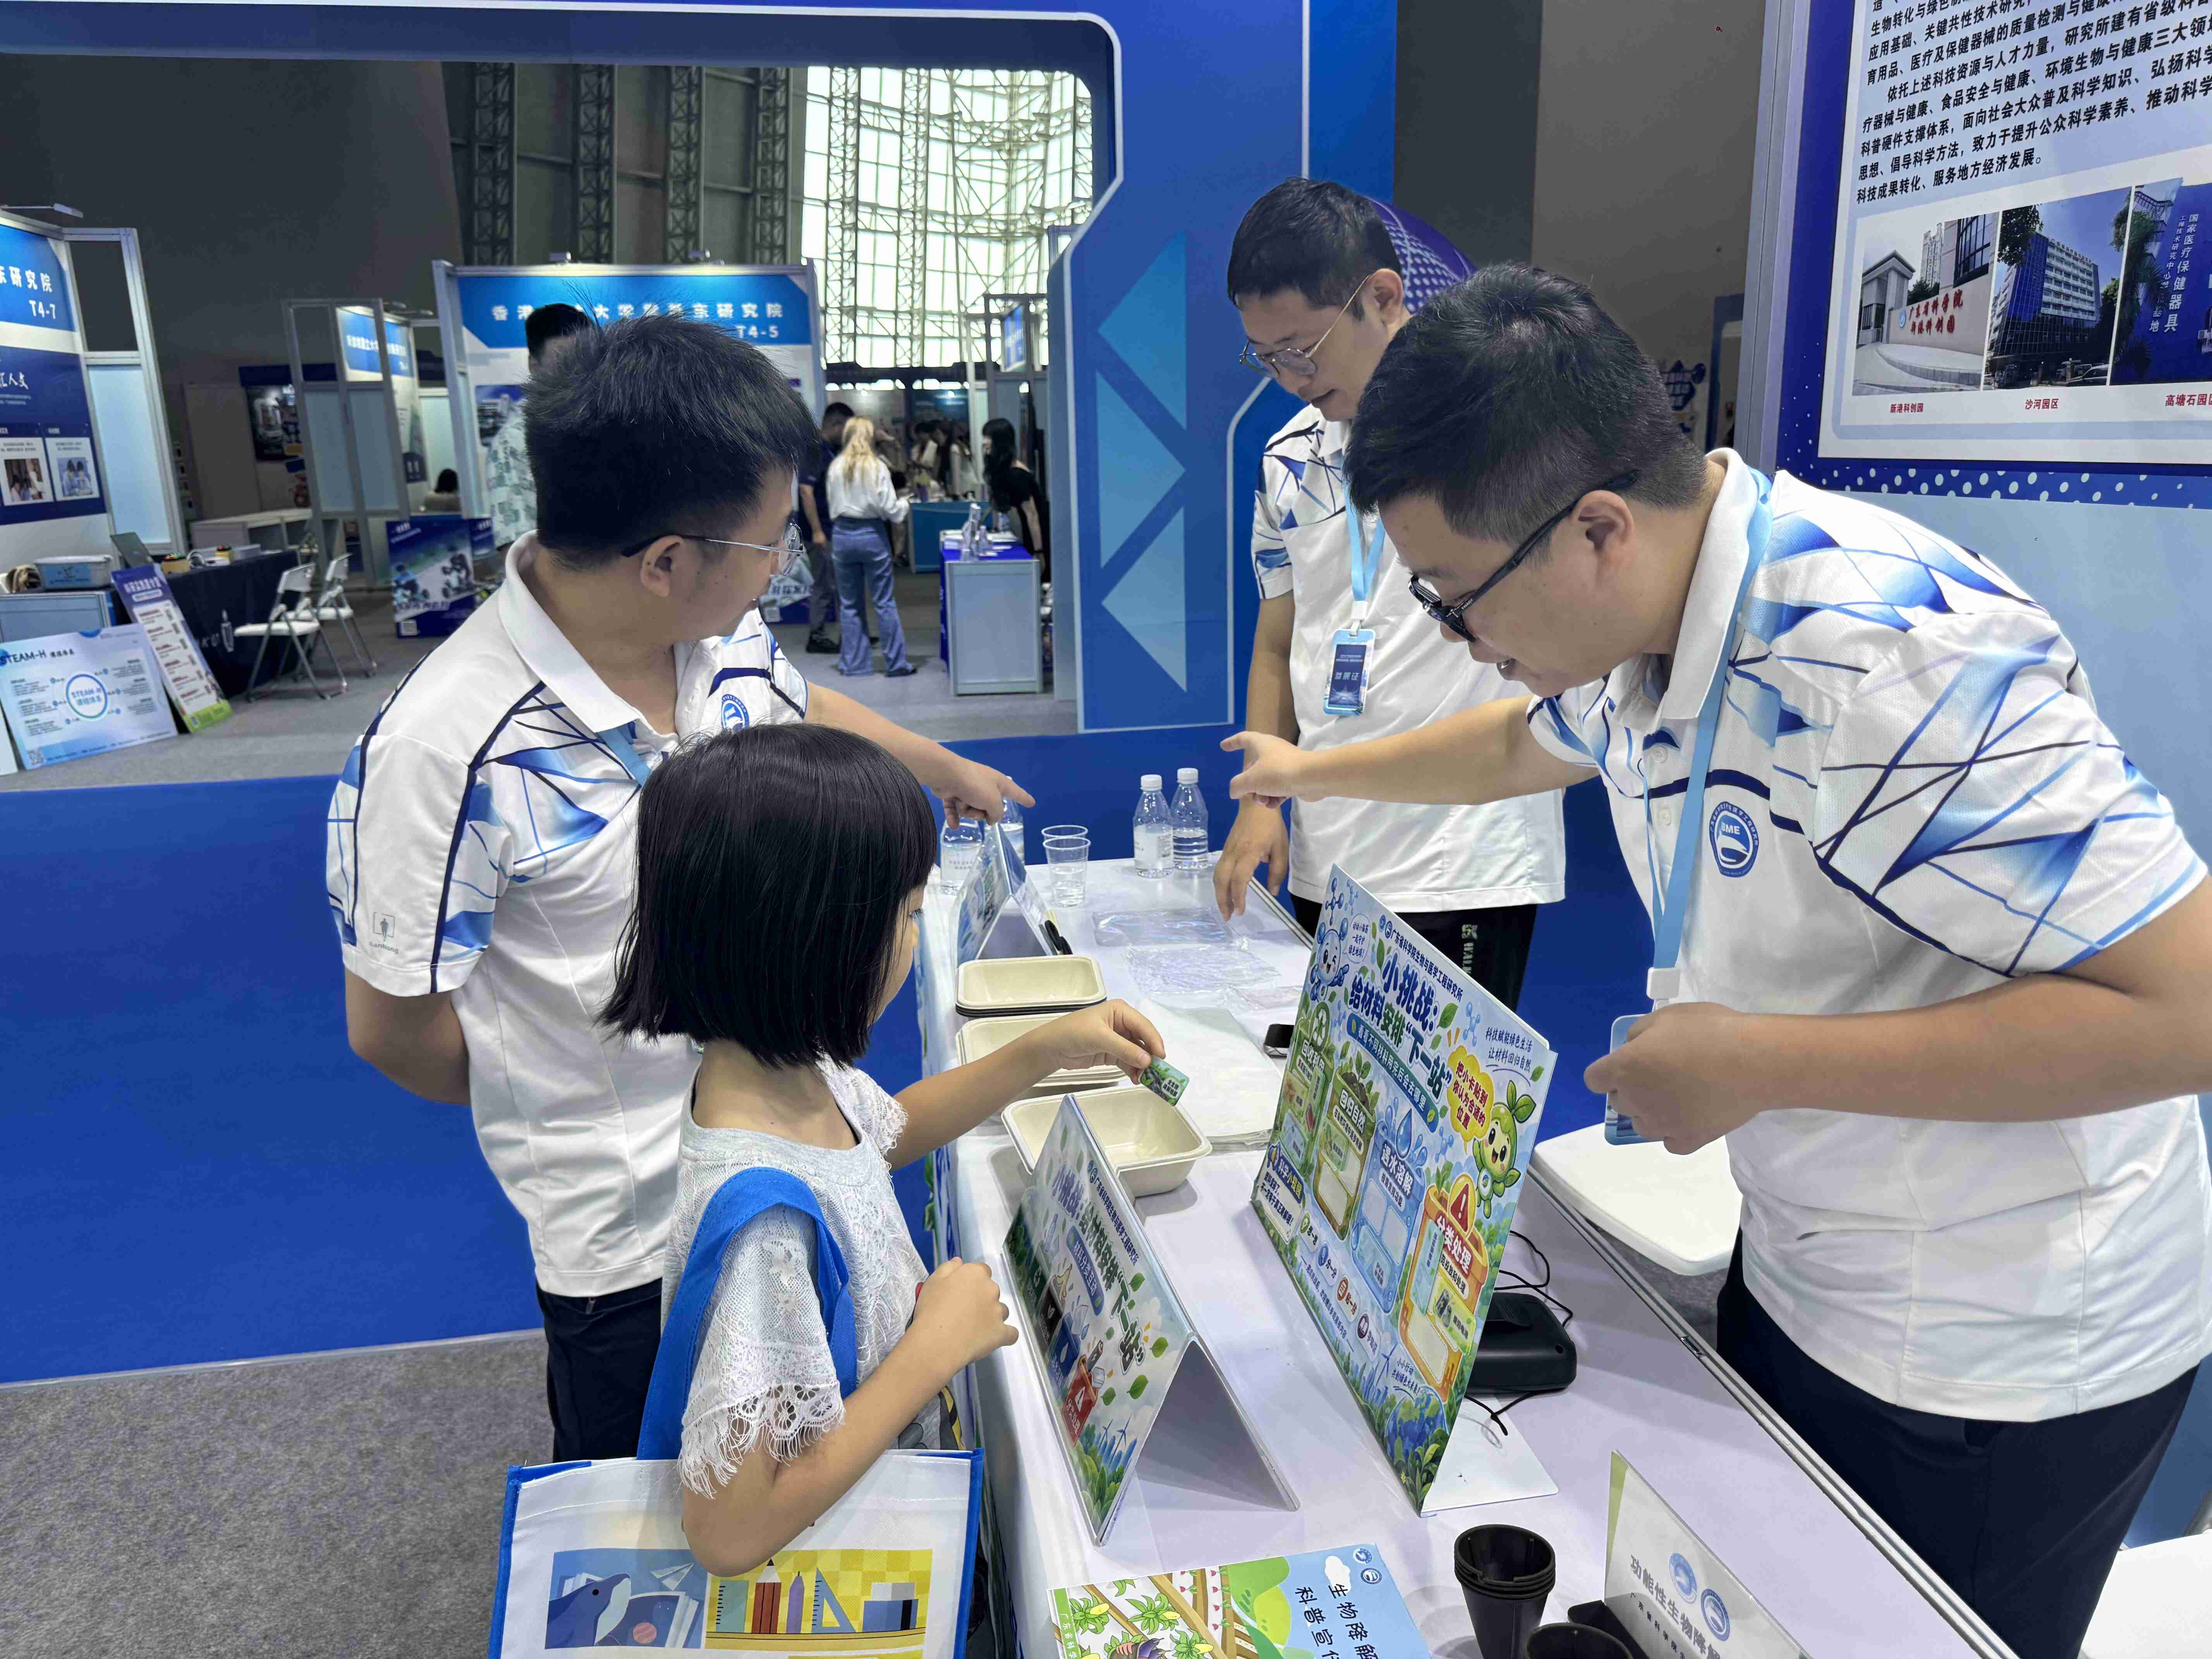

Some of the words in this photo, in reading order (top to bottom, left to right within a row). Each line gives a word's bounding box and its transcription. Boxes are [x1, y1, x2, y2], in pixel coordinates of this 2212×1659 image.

[1856, 148, 2041, 204] 科技成果转化、服务地方经济发展。
[2164, 214, 2198, 333] 国家医疗保健器具
[29, 300, 56, 319] T4-7
[735, 325, 779, 338] T4-5
[1890, 403, 1924, 413] 新港科创园
[2025, 398, 2059, 410] 沙河园区
[1390, 928, 1464, 1002] 广东省科学院生物与医学工程研究所
[1348, 972, 1453, 1101] 给材料安排“下一站”
[1484, 1026, 1533, 1055] 科技赋能绿色生活
[1487, 1045, 1532, 1073] 让材料回归自然
[1358, 1023, 1427, 1111] 看看不同材料用完后会去哪里
[1455, 1060, 1488, 1108] 把小卡贴到
[1339, 1087, 1367, 1134] 回归自然
[1451, 1079, 1486, 1128] 你认为合适的
[1455, 1104, 1471, 1130] 位置
[1380, 1141, 1414, 1197] 遇水溶解
[1325, 1255, 1337, 1281] 分一分
[1439, 1252, 1466, 1295] 范投放和处理
